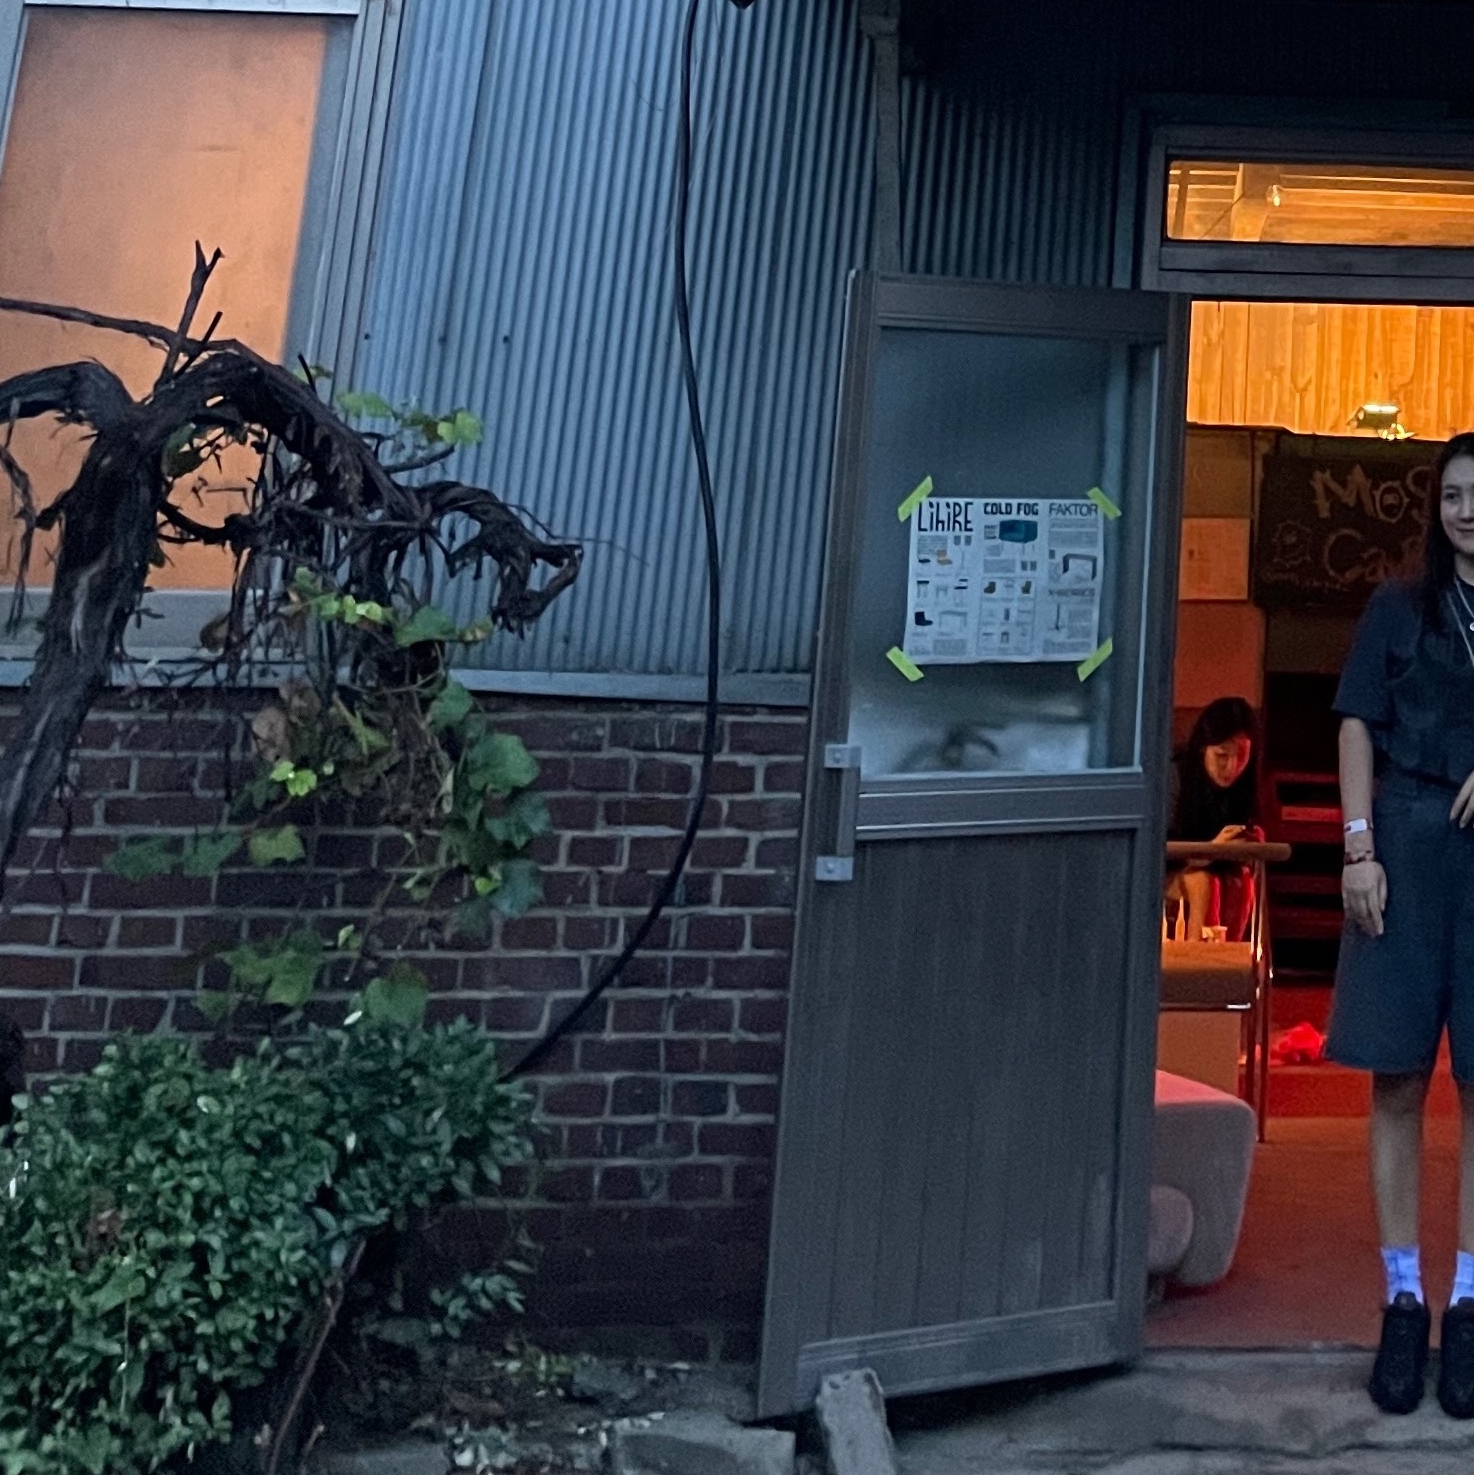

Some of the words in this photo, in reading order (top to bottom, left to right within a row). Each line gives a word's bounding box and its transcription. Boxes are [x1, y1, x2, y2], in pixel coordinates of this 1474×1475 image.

[983, 502, 1013, 515] COLD
[1016, 502, 1039, 516] FOG
[1048, 502, 1099, 517] FAKTOR
